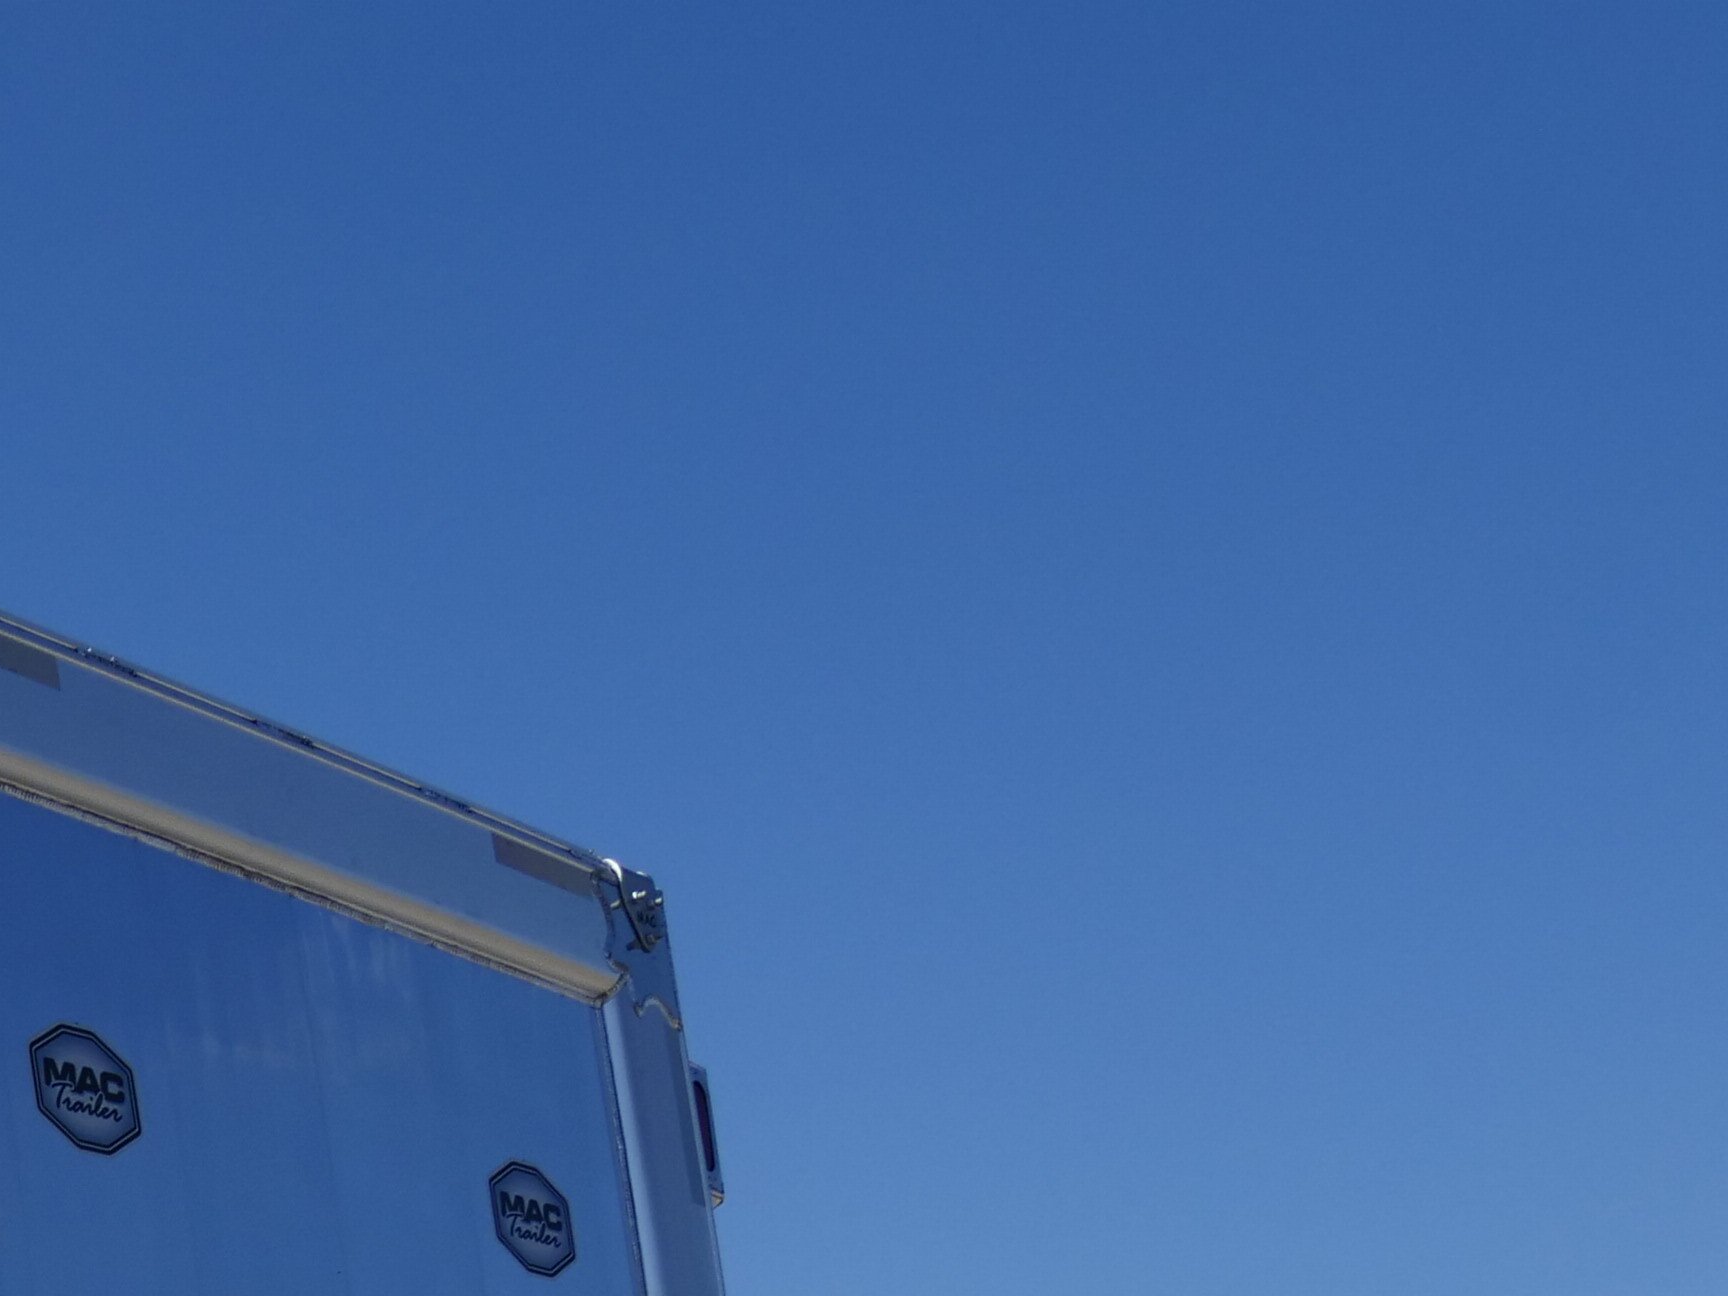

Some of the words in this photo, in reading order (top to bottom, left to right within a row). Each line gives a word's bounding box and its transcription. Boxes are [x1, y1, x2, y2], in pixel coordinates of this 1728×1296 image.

[43, 1057, 125, 1104] MAC
[51, 1082, 123, 1122] Trailer
[500, 1191, 563, 1232] MAC
[506, 1213, 562, 1248] Trailer
